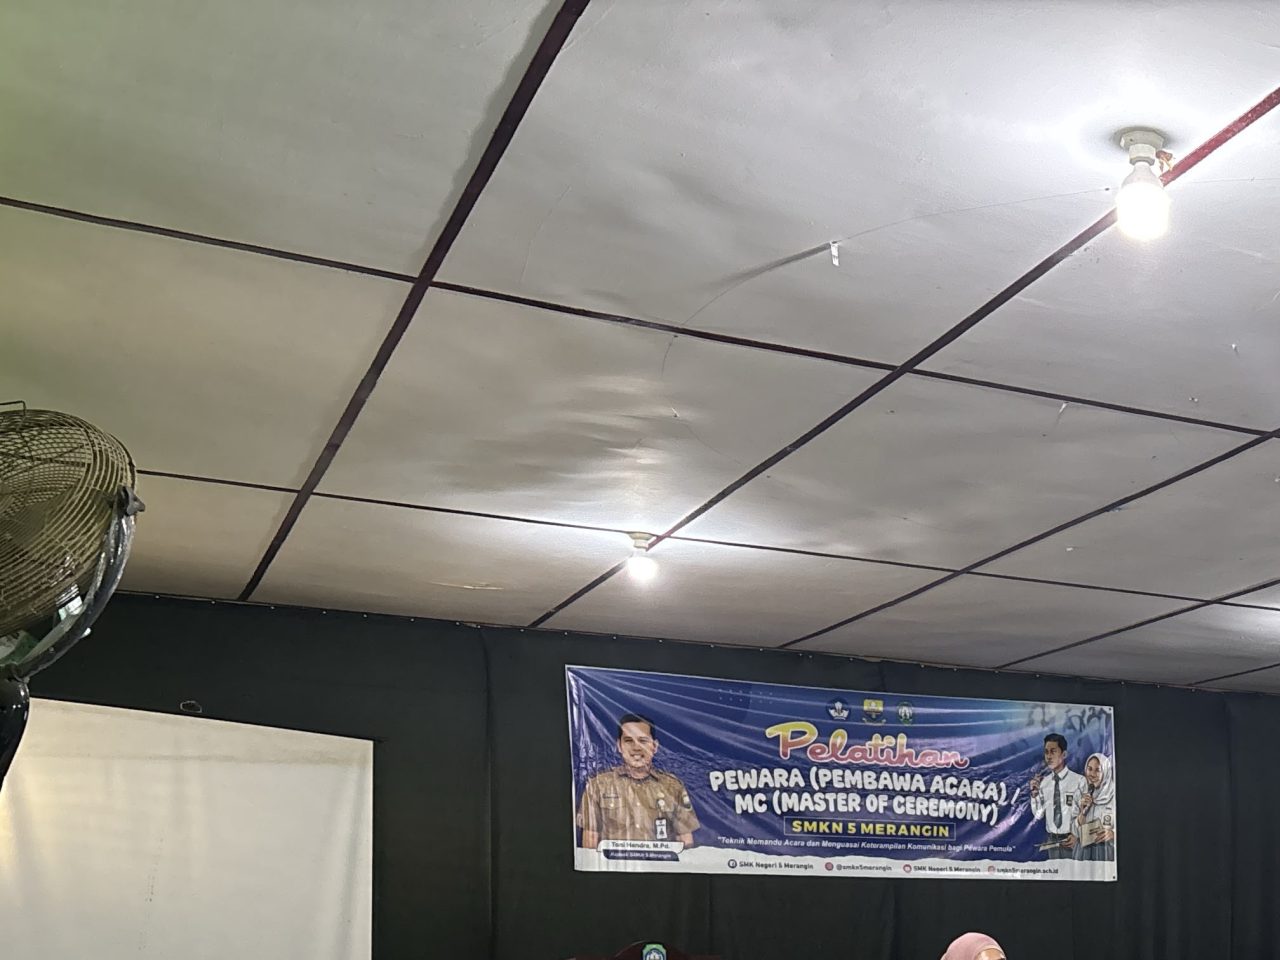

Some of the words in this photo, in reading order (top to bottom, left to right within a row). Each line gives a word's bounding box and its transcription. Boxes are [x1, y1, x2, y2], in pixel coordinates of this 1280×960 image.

[766, 720, 970, 769] Pelatihan
[709, 768, 805, 792] PEWARA
[810, 766, 926, 793] (PEMBAWA
[929, 773, 1007, 805] ACARA)
[734, 793, 768, 815] MC
[772, 789, 861, 815] (MASTER
[865, 794, 888, 813] OF
[892, 796, 1000, 826] CEREMONY)
[746, 837, 782, 847] Memandu
[783, 839, 805, 847] Acara
[806, 840, 820, 848] dan
[821, 841, 860, 850] Menguasai
[861, 841, 906, 851] Keterampilan
[906, 842, 947, 851] Komunikasi
[947, 844, 963, 853] bagi
[791, 819, 842, 835] SMKN
[848, 821, 857, 835] 5
[860, 822, 949, 838] MERANGIN
